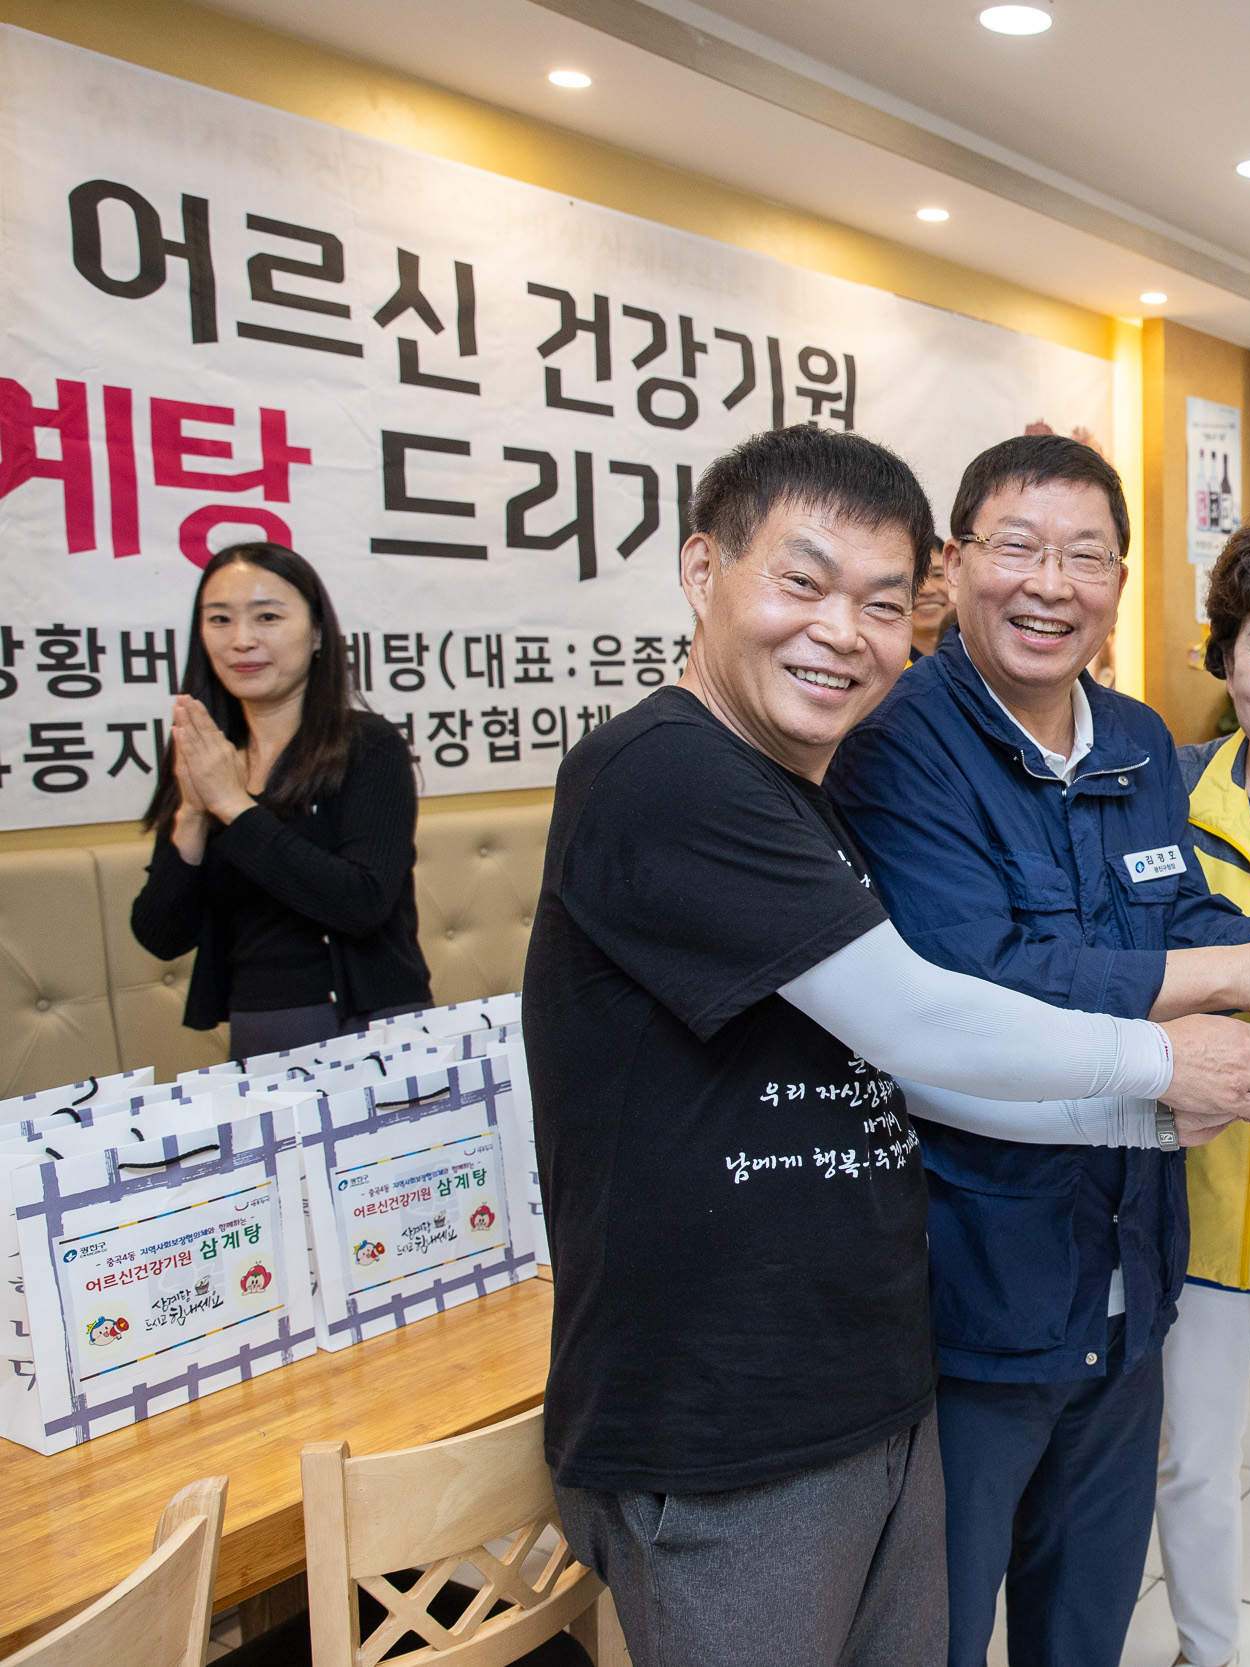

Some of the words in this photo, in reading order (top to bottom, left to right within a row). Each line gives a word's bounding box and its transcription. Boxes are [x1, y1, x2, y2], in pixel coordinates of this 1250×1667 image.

[68, 178, 481, 396] 어르신
[527, 281, 856, 431] 건강기원
[0, 718, 167, 794] 동지
[760, 1081, 806, 1107] 우리
[815, 1081, 863, 1107] 자신
[725, 1151, 803, 1184] 남에게
[813, 1147, 870, 1179] 행복
[353, 1187, 432, 1219] 어르신건강기원
[436, 1168, 487, 1197] 삼계탕
[79, 1241, 106, 1254] 광진구
[85, 1249, 192, 1293] 어르신건강기원
[200, 1223, 262, 1260] 삼계탕
[106, 1251, 136, 1268] 중곡4동
[218, 1217, 247, 1233] 함께하는
